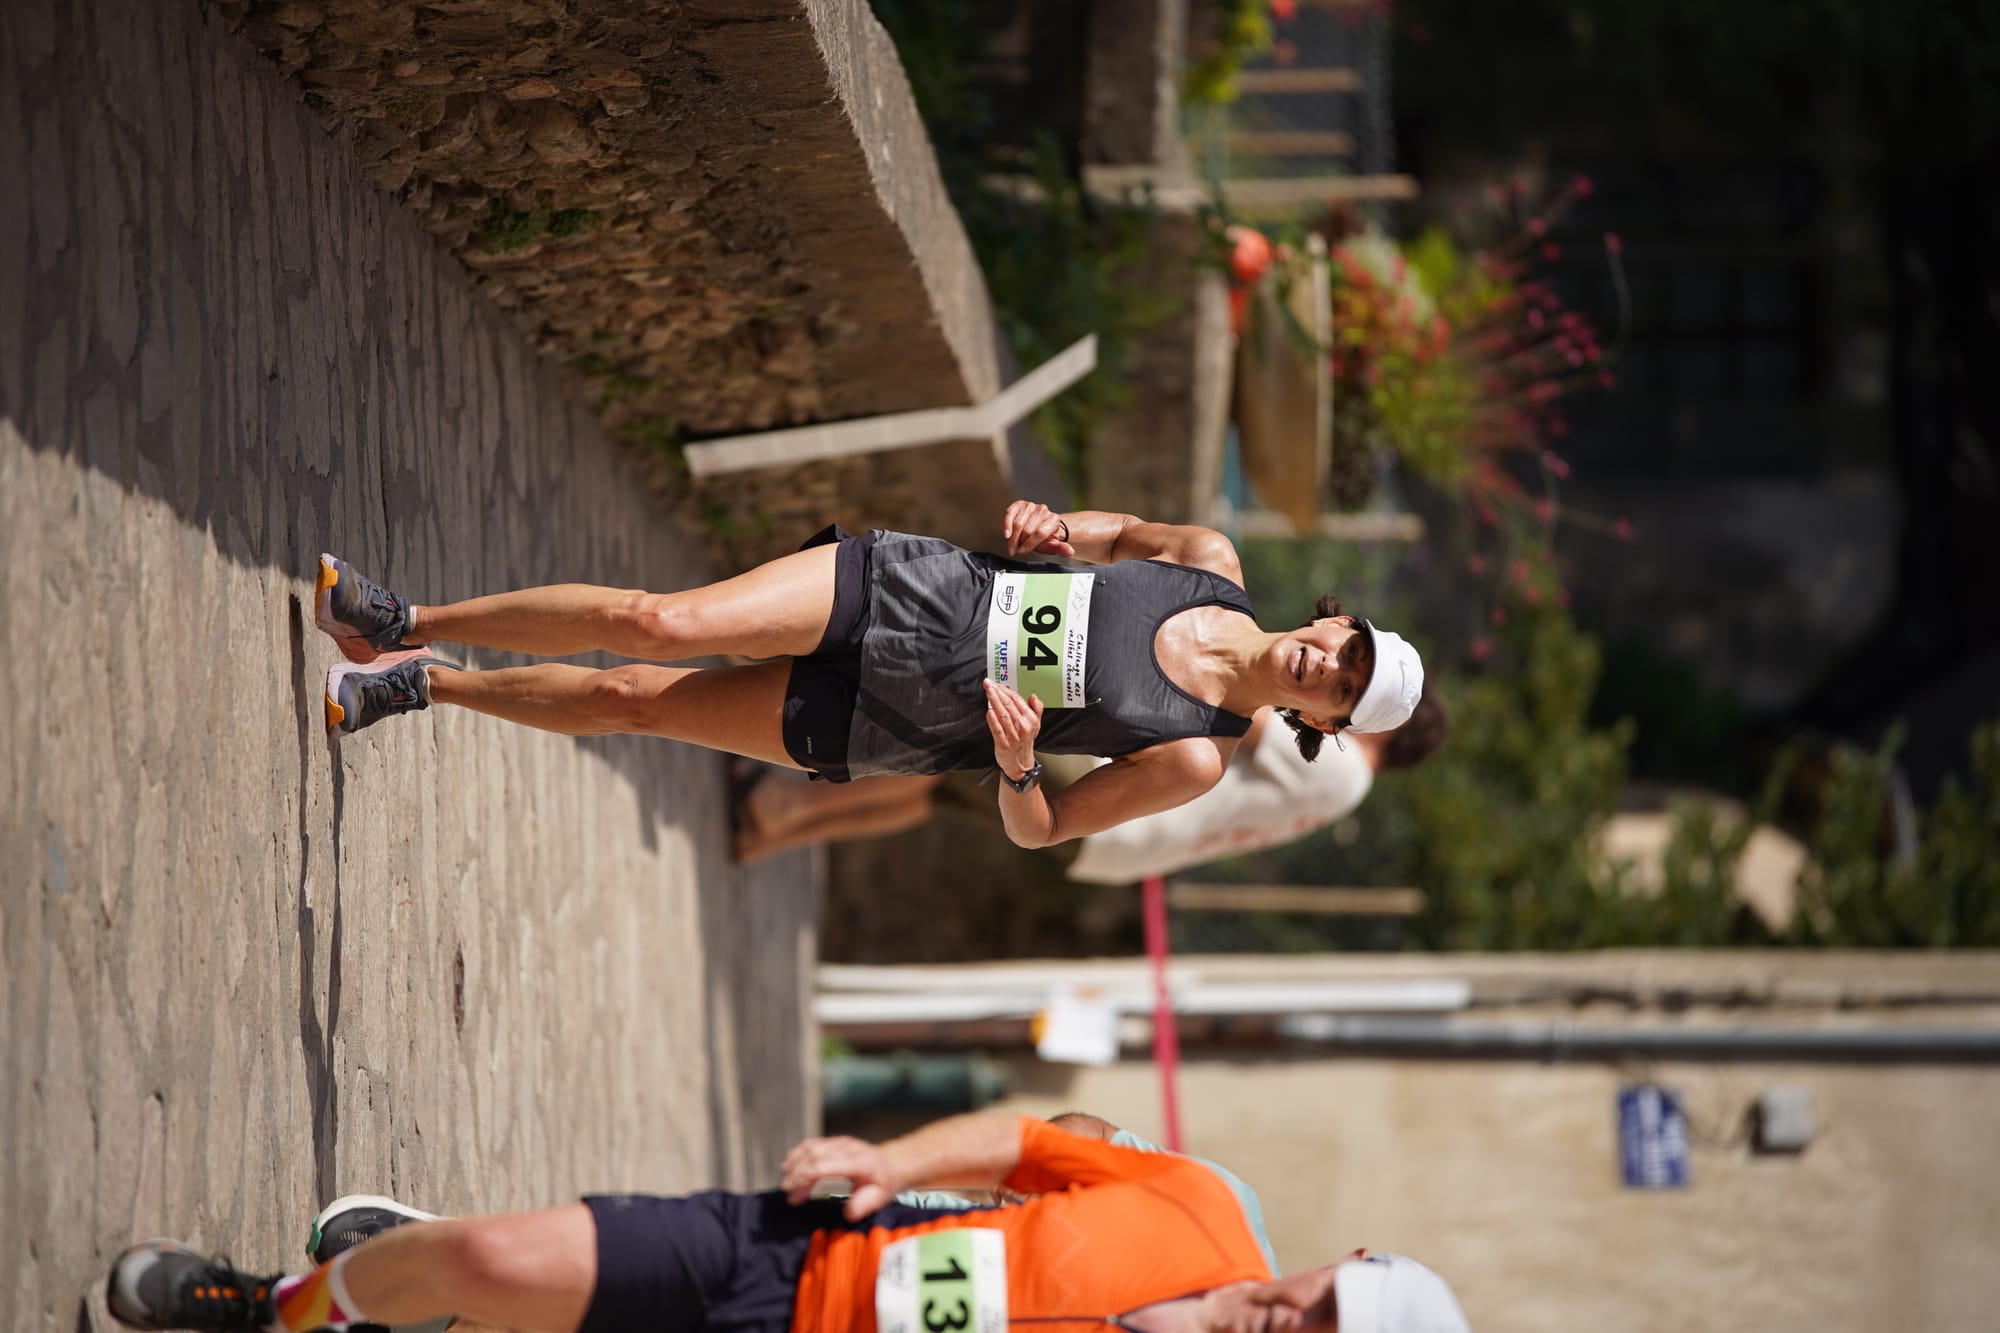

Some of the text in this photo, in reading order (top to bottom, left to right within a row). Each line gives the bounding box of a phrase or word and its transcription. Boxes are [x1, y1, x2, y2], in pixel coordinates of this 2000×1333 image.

[1004, 586, 1014, 611] BFP
[1000, 640, 1008, 681] TUFF'S
[1020, 605, 1061, 671] 94
[1073, 634, 1084, 677] Challenge
[1066, 629, 1075, 702] vallées cévenoles
[923, 1257, 969, 1333] 13
